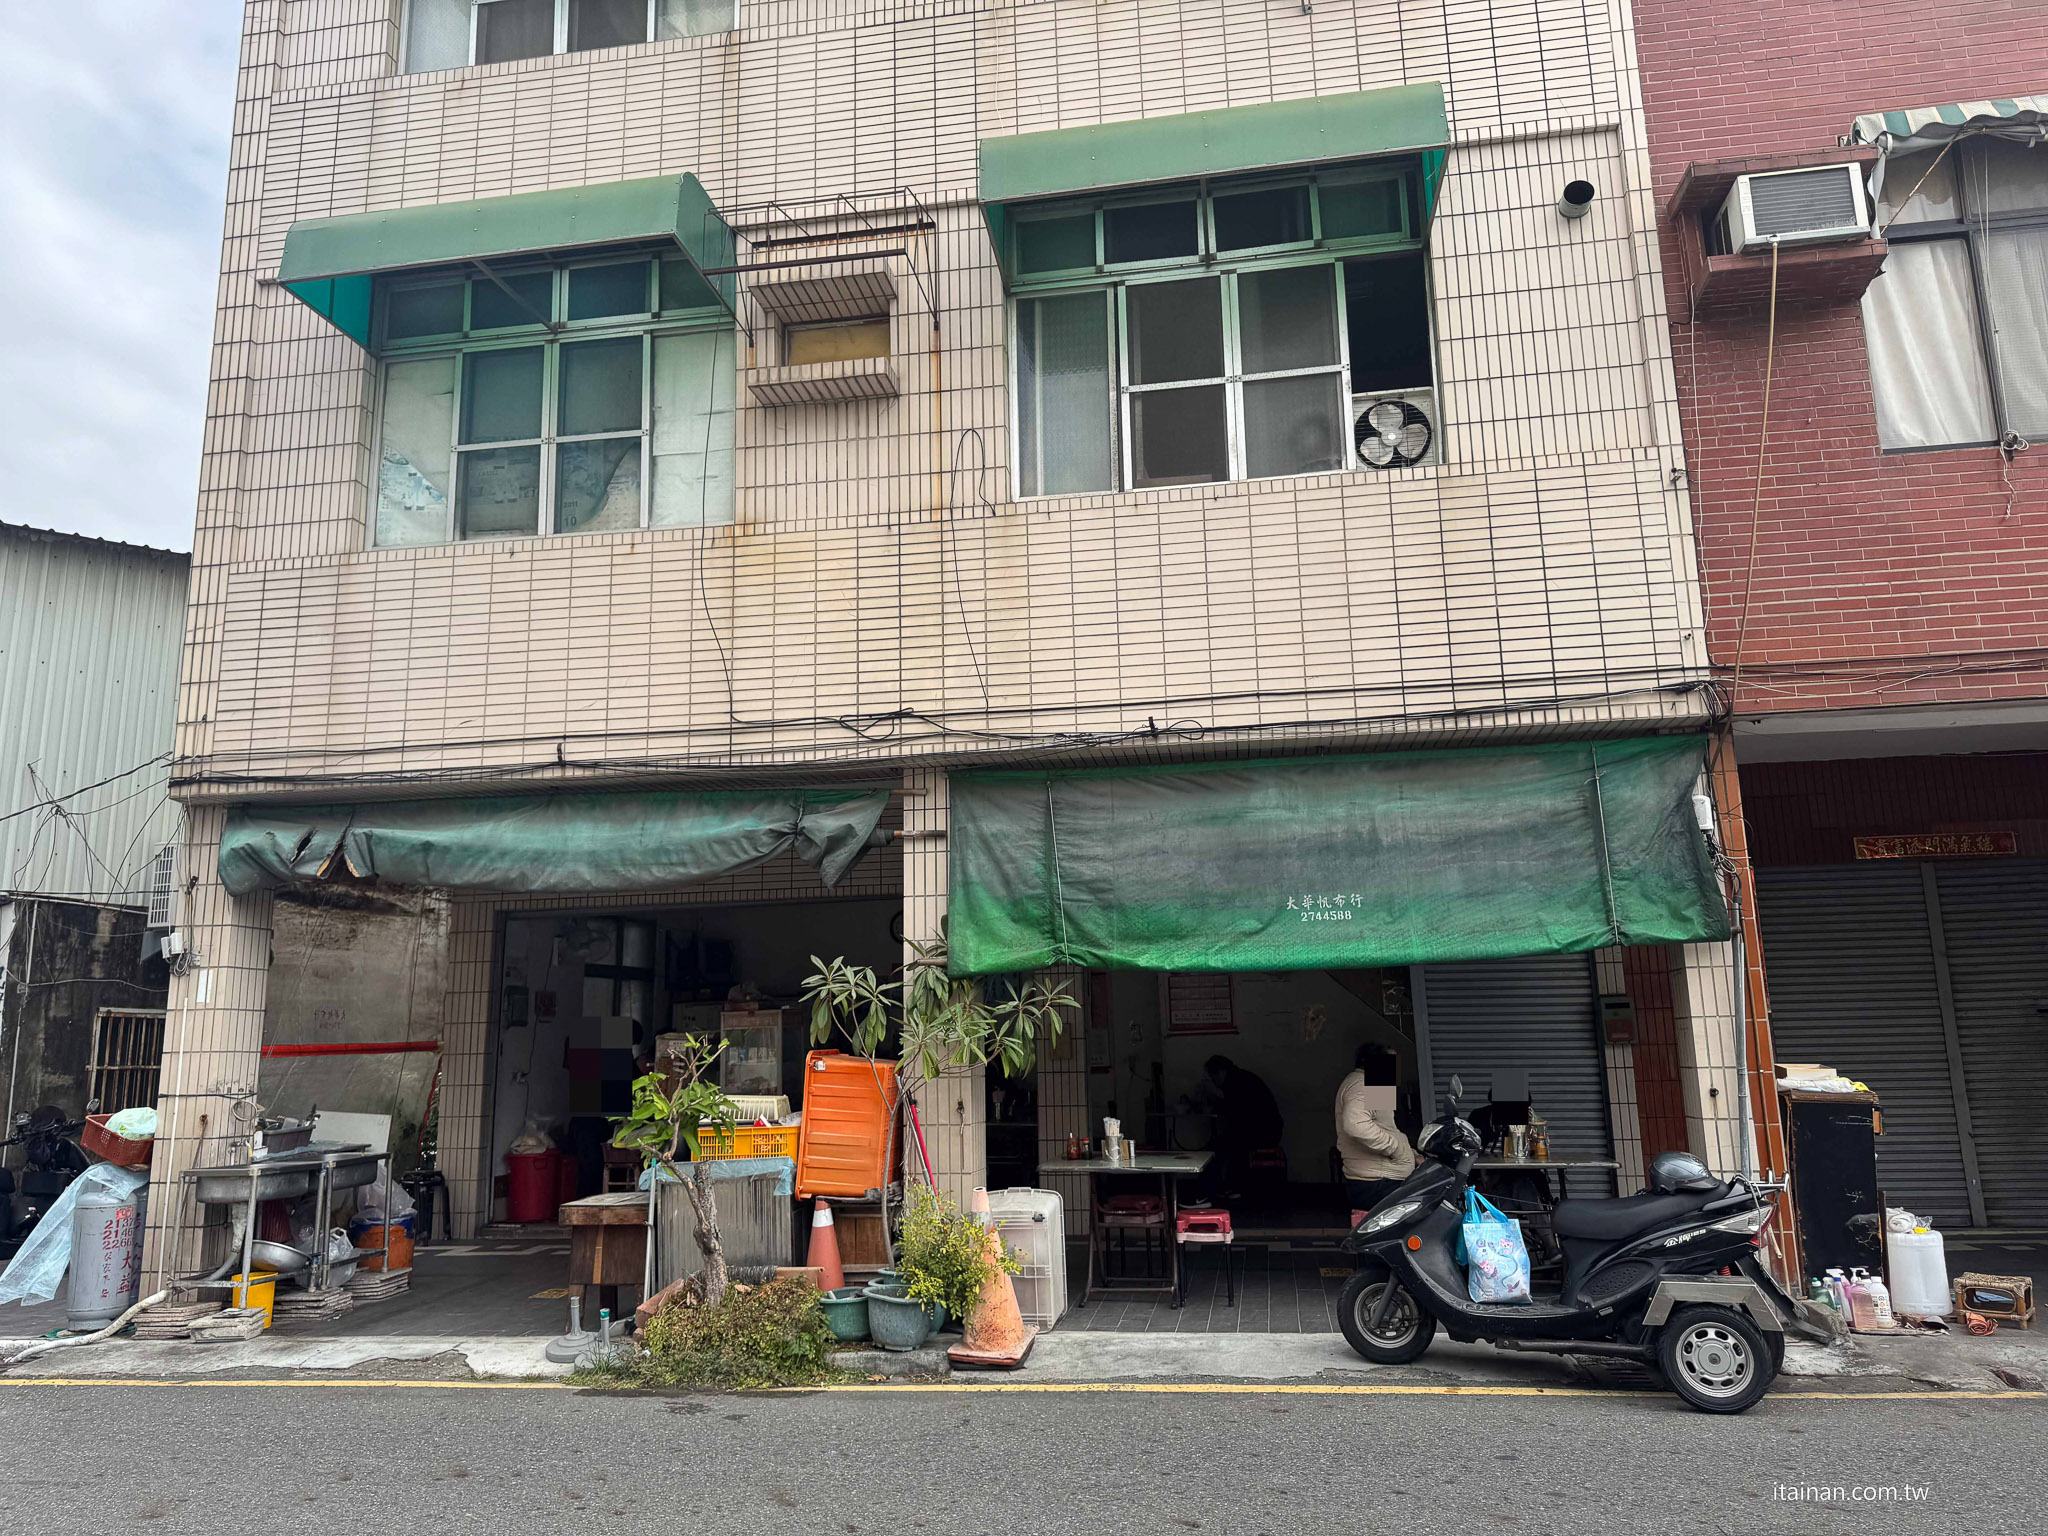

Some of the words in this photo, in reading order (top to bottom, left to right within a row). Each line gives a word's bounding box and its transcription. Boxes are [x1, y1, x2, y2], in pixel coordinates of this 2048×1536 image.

[1286, 893, 1364, 911] 大華帆布行
[1300, 910, 1353, 922] 2744588
